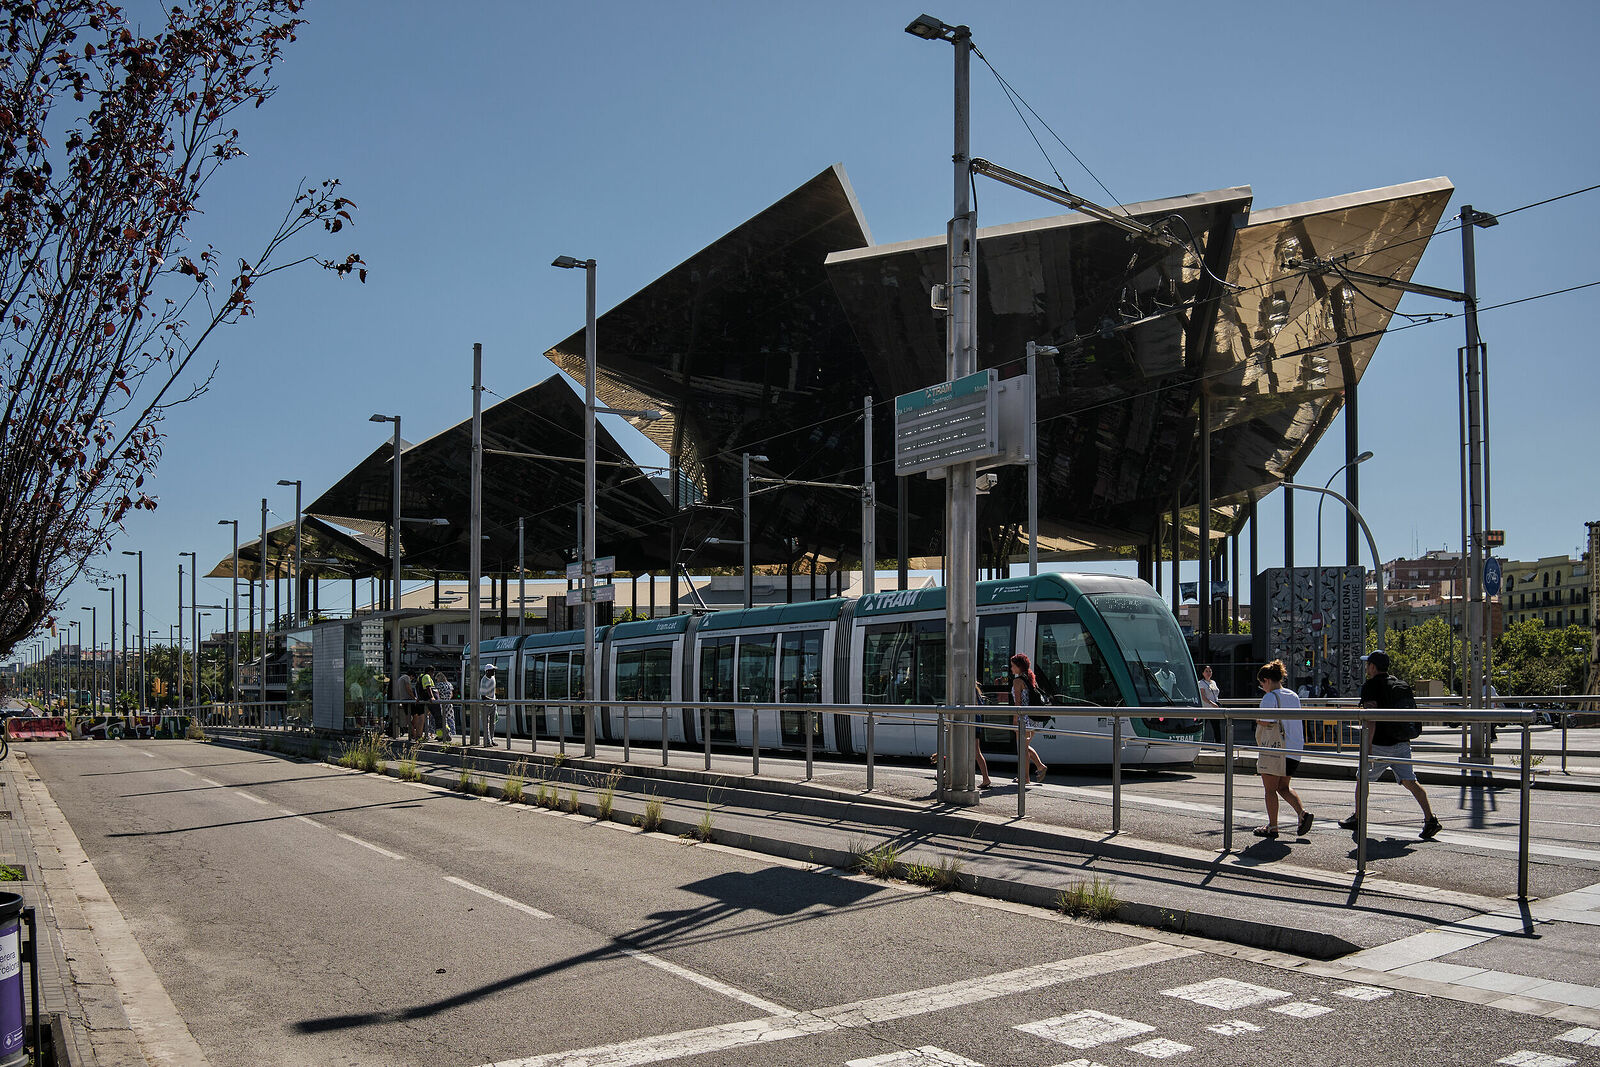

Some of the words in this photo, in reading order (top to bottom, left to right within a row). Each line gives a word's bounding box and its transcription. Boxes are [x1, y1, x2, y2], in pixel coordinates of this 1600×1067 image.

[932, 383, 952, 395] TRAM
[875, 591, 920, 610] TRAM
[1342, 583, 1351, 640] BARCELONA
[1351, 584, 1360, 630] BELLCAIRE
[1351, 631, 1360, 643] DE
[1342, 643, 1351, 685] ENCANTS
